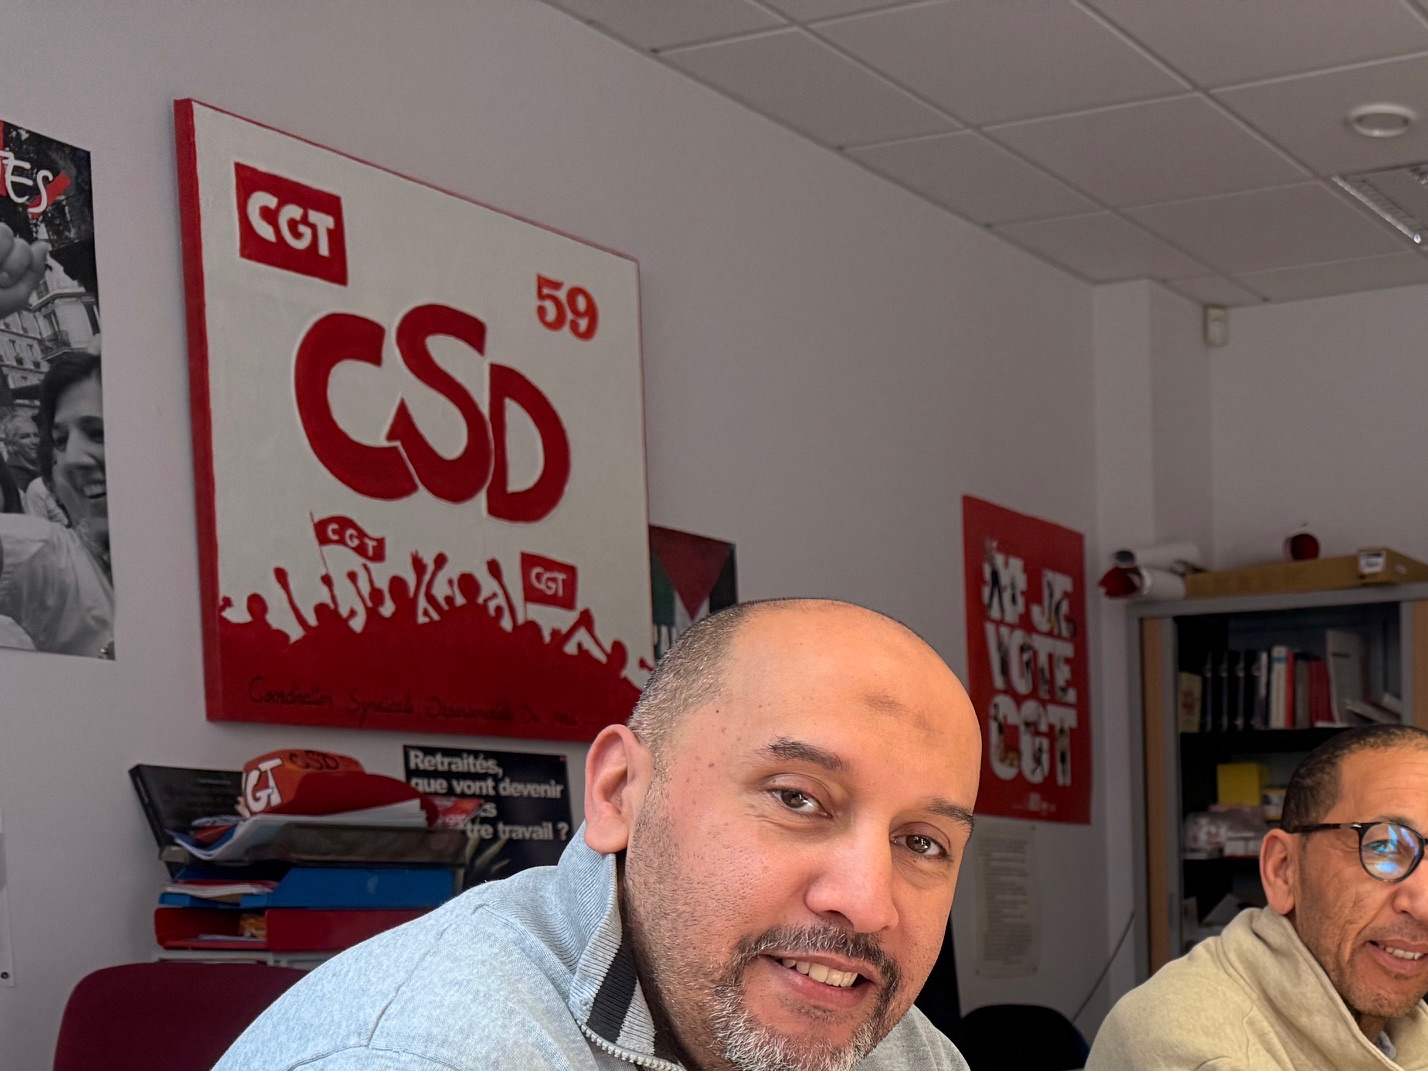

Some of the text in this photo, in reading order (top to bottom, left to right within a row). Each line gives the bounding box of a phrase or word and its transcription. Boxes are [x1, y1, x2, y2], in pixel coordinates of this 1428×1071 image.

[246, 189, 334, 257] CGT
[536, 273, 597, 341] 59
[295, 303, 571, 523] CSD
[326, 522, 379, 557] CGT
[531, 566, 568, 597] CGT
[985, 620, 1078, 704] VOTE
[409, 751, 503, 777] Retraités,
[988, 694, 1079, 788] CGT
[242, 757, 284, 813] GT
[452, 777, 497, 796] vont
[498, 778, 564, 800] devenir
[497, 821, 554, 841] travail
